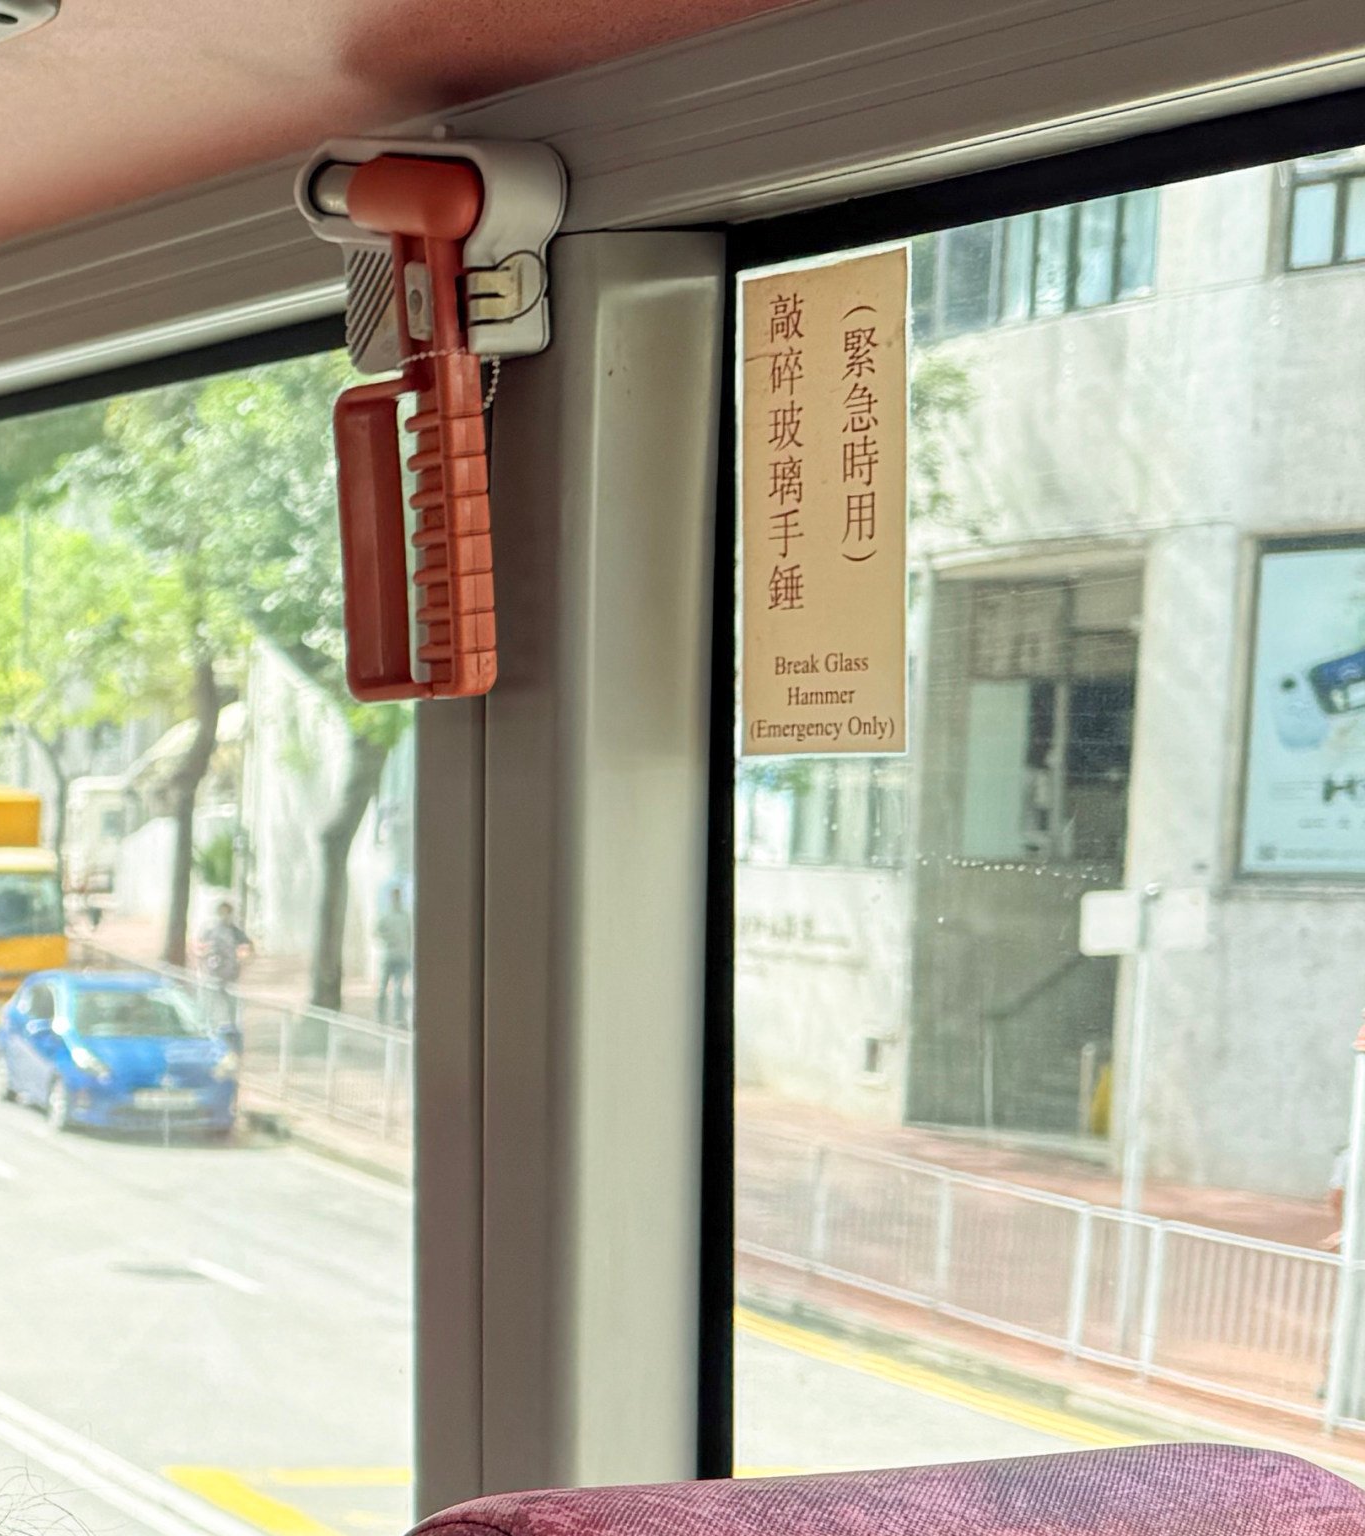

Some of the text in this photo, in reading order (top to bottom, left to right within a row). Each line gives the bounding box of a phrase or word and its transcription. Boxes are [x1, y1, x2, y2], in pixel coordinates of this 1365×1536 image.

[768, 292, 805, 610] 敲碎玻璃手錘
[774, 652, 869, 675] Break Glass
[787, 686, 856, 706] Hammer
[750, 715, 895, 742] (Emergency Only)
